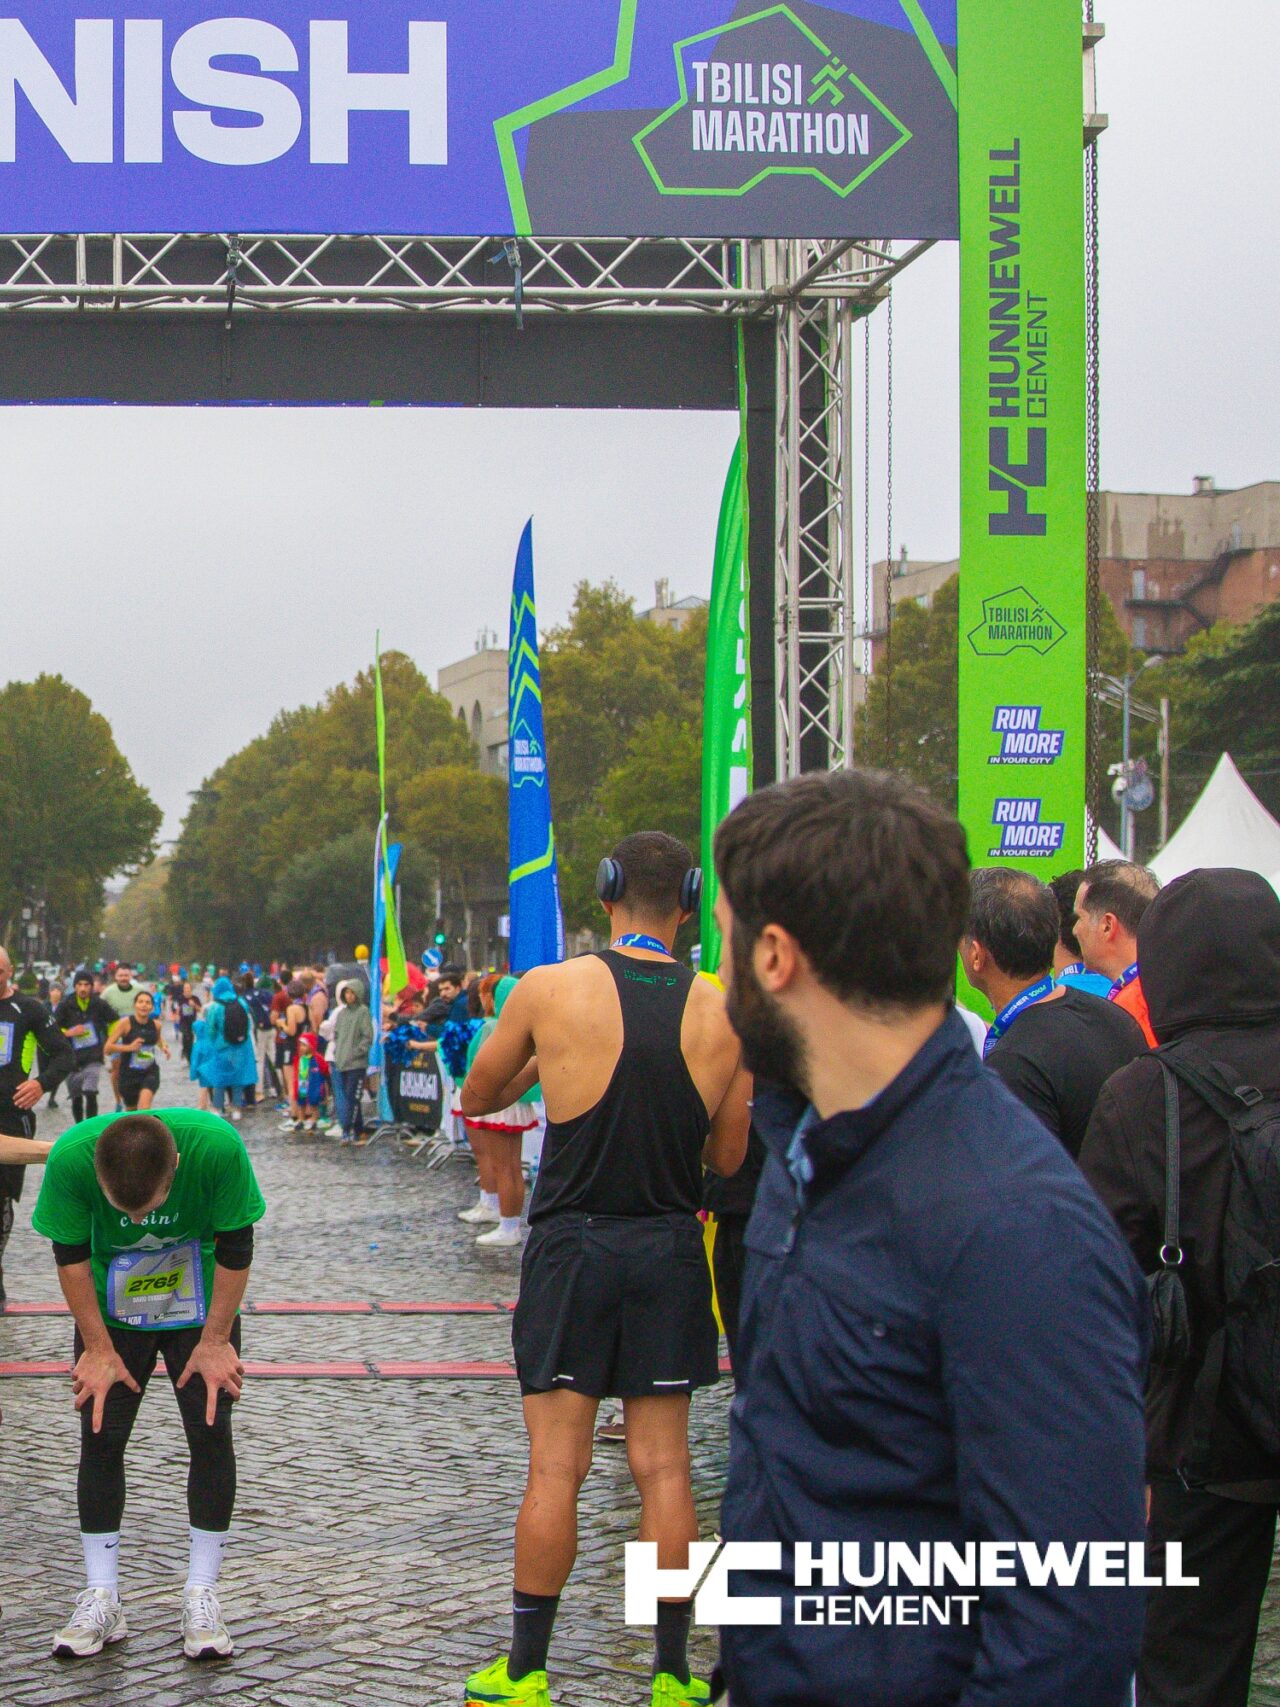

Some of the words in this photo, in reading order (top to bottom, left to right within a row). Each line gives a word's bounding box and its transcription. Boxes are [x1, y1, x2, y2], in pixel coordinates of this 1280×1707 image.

[691, 61, 803, 106] TBILISI
[691, 110, 869, 156] MARATHON
[988, 137, 1020, 418] HUNNEWELL
[1026, 289, 1048, 418] CEMENT
[988, 607, 1029, 624] TBILISI
[988, 624, 1053, 641] MARATHON
[996, 708, 1037, 731] RUN
[1004, 732, 1061, 755] MORE
[989, 757, 1001, 765] IN
[1001, 757, 1029, 765] YOUR
[1029, 757, 1053, 765] CITY
[996, 801, 1037, 823] RUN
[1004, 824, 1061, 847] MORE
[989, 849, 1001, 857] IN
[1001, 849, 1029, 857] YOUR
[1029, 849, 1053, 857] CITY
[1001, 995, 1030, 1023] FINISHER
[1028, 984, 1048, 998] 10KM
[120, 1210, 179, 1228] csino
[128, 1272, 179, 1292] 2765
